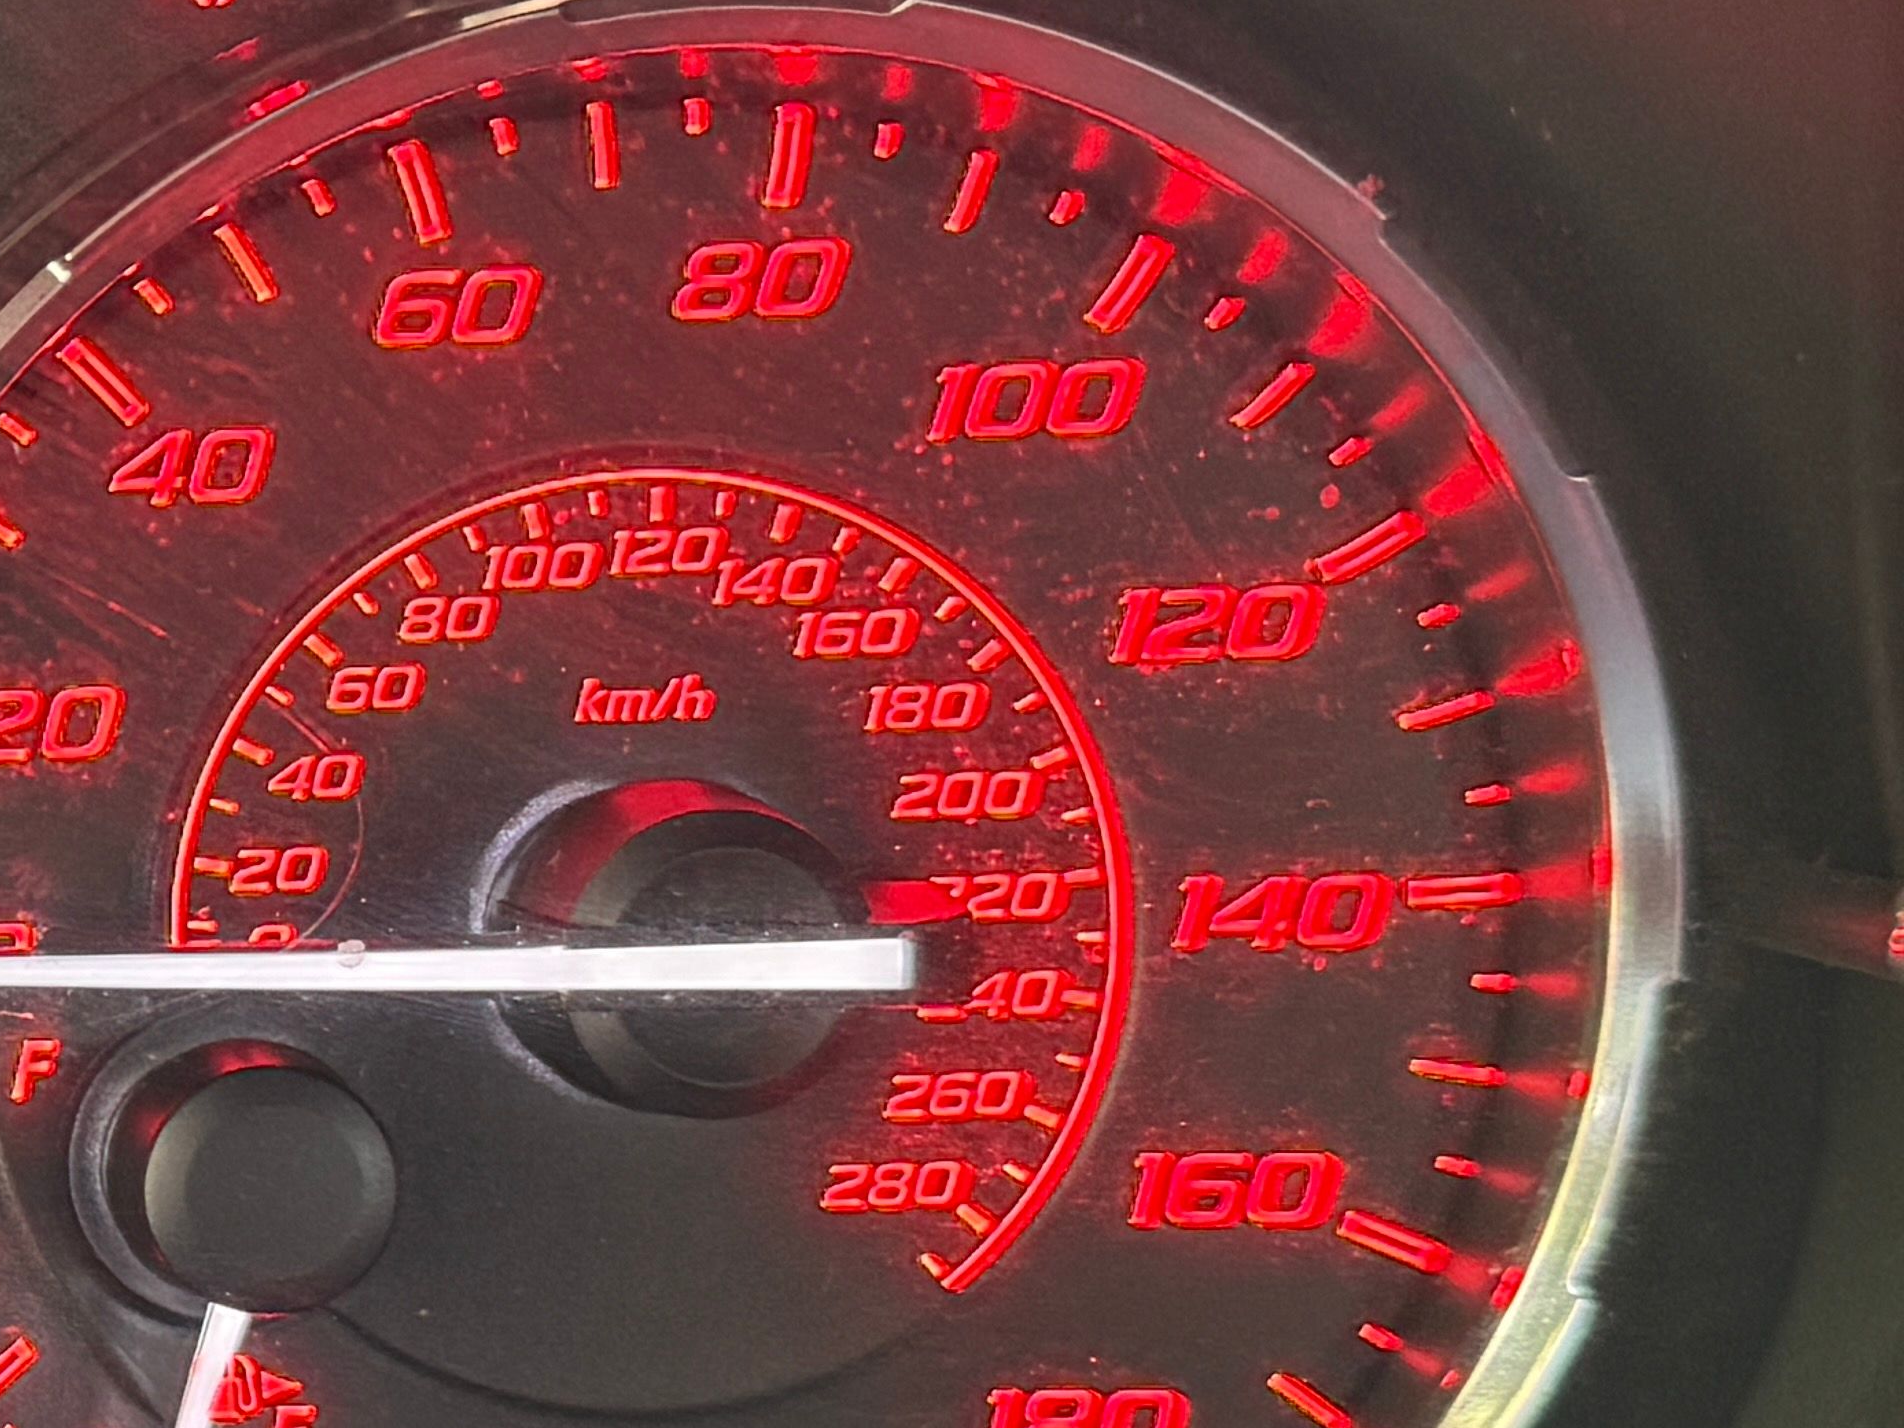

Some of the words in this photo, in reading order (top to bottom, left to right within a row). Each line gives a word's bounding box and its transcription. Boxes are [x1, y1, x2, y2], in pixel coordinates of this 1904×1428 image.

[370, 263, 544, 348] 60
[672, 237, 851, 321] 80
[925, 357, 1146, 445] 100
[107, 424, 277, 508] 40
[483, 542, 604, 592] 100
[609, 526, 730, 576] 120
[712, 557, 841, 607] 140
[398, 594, 500, 645] 80
[792, 608, 921, 660] 160
[1109, 584, 1327, 667] 120
[326, 661, 426, 713] 60
[573, 673, 717, 725] km/h
[863, 681, 990, 734] 180
[267, 751, 367, 801] 40
[891, 772, 1040, 821] 200
[228, 845, 330, 897] 20
[1172, 873, 1393, 953] 140
[916, 970, 1068, 1024] 40
[9, 1037, 62, 1105] F
[881, 1071, 1033, 1124] 260
[818, 1160, 972, 1214] 280
[1127, 1148, 1348, 1231] 160
